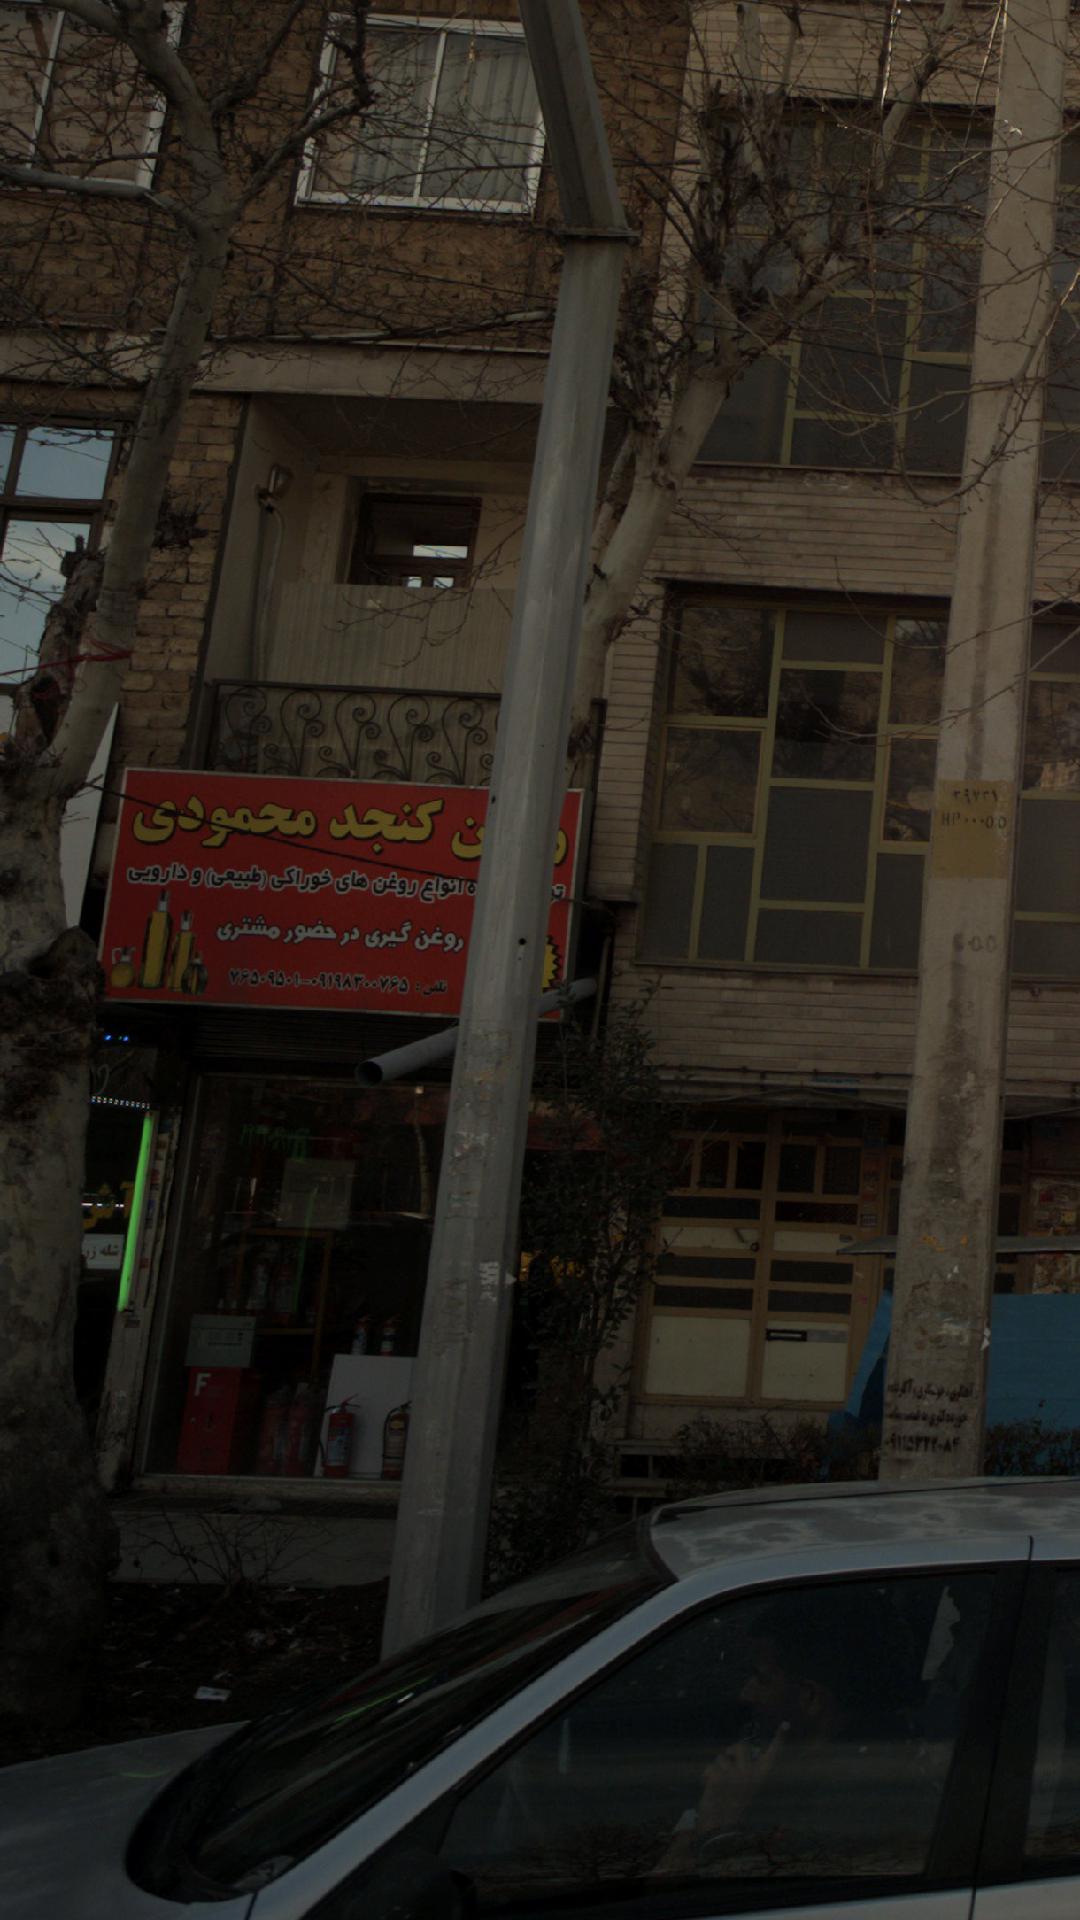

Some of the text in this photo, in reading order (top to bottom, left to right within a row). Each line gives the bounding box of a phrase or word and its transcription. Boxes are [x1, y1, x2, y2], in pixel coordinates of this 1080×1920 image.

[131, 796, 317, 848] محمودی
[329, 799, 445, 855] کنجد
[127, 864, 187, 883] دارویی
[192, 869, 202, 886] و
[206, 866, 268, 889] (طبیعی)
[271, 868, 331, 893] خوراکی
[335, 869, 368, 892] های
[373, 874, 418, 898] روغن
[421, 878, 465, 902] انواع
[216, 916, 464, 952] روغن گیری در حضور مشتری
